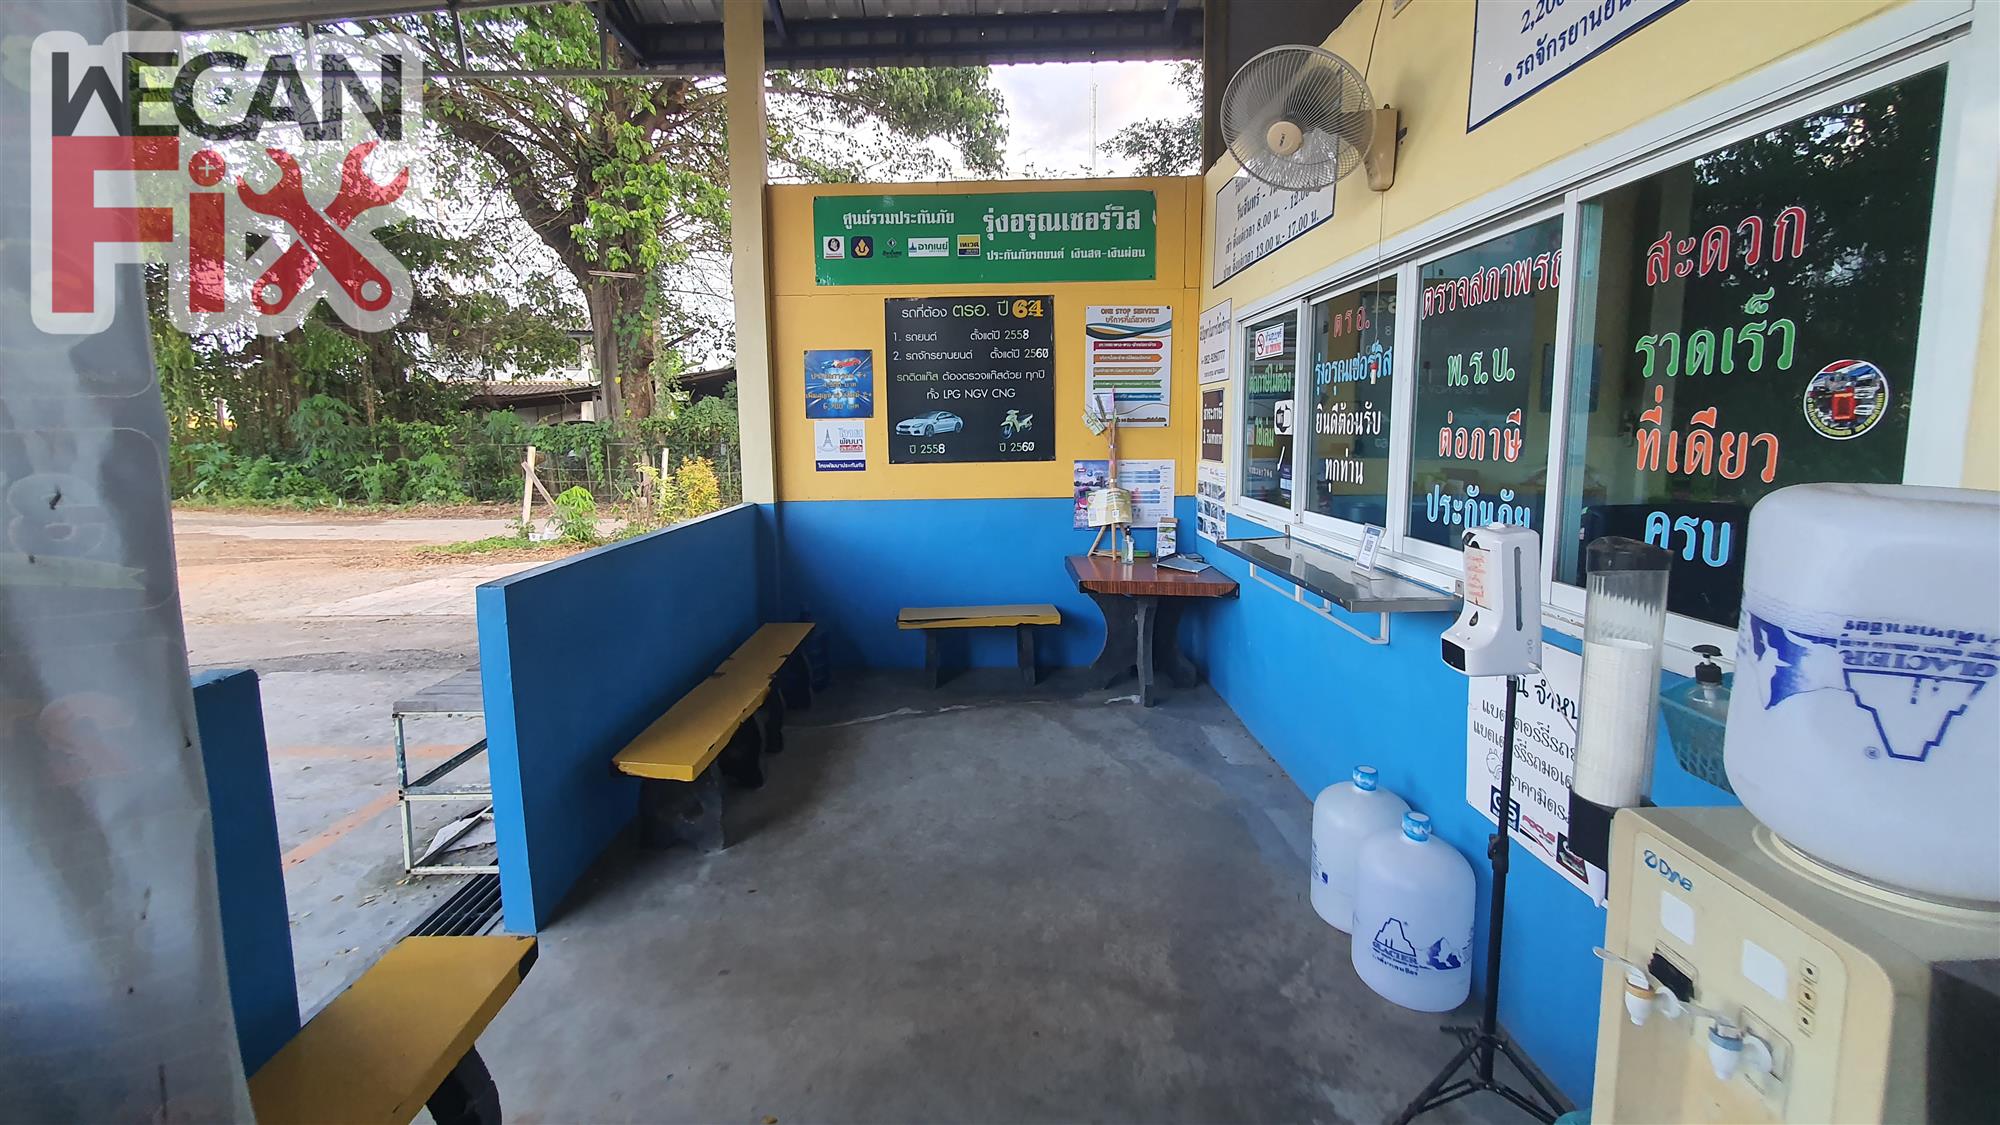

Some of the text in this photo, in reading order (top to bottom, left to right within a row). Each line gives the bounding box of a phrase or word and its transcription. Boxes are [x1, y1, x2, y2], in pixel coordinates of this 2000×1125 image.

[1520, 0, 1566, 34] 2,20
[843, 209, 955, 229] ศูนย์รวมประกันภัย
[983, 204, 1140, 240] รุ่งอรุณเซอร์วิส
[1288, 213, 1308, 238] 17.00
[987, 247, 1145, 261] ประกันภัยรถยนต์ เงินสด-เงินผ่อน
[1646, 206, 1807, 286] สะดวก
[902, 300, 1043, 318] รถที่ต้อง ตรอ. ปี 64
[905, 332, 937, 342] รถยนต์
[970, 329, 1000, 341] ตั้งแต่ปี
[1005, 329, 1029, 340] 2558
[1635, 287, 1796, 378] รวดเร็ว
[906, 350, 973, 360] รถจักรยานยนต์
[990, 347, 1020, 359] ตั้งแต่ปี
[1025, 348, 1049, 359] 2560
[1026, 370, 1045, 381] ทุกปี
[927, 388, 1015, 400] ทั้ง LPG NGV CNG
[1315, 401, 1381, 435] ยินดีต้อนรับ
[1011, 442, 1035, 452] 2560
[1438, 408, 1521, 463] ต่อภาษี
[1636, 384, 1780, 483] ที่เดียว
[921, 443, 945, 454] 2558
[1325, 448, 1364, 493] ทุกท่าน
[1644, 510, 1731, 567] ครบ
[1839, 649, 1998, 678] GLACIER
